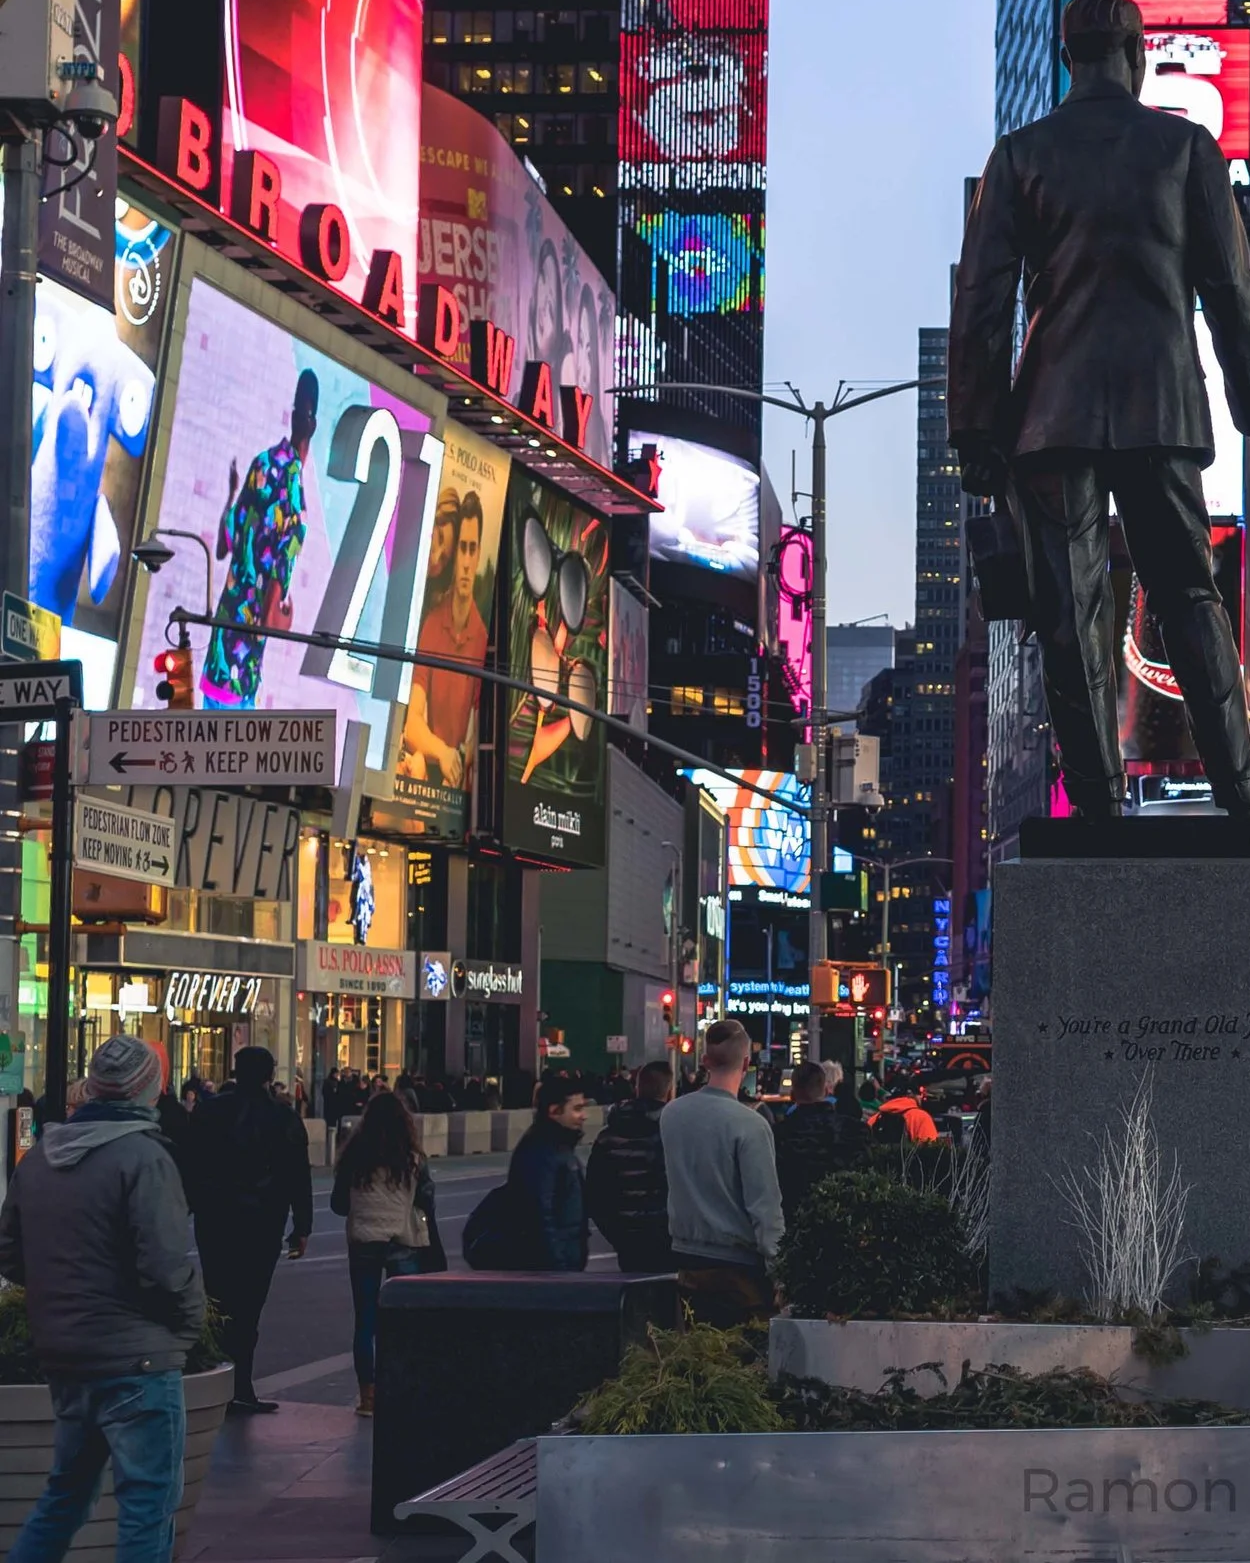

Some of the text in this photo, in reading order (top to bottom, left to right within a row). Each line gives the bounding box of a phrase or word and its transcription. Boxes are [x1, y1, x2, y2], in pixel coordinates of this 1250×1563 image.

[53, 229, 104, 273] THE BROADWAY
[62, 255, 91, 284] MUSICAL
[157, 97, 595, 450] BROADWAY
[326, 406, 446, 705] 21
[11, 614, 27, 643] ONE
[14, 679, 63, 704] WAY
[746, 657, 762, 729] 1500
[108, 720, 325, 743] PEDESTRIAN FLOW ZONE
[205, 751, 324, 773] KEEP MOVING
[408, 782, 464, 806] AUTHENTICALLY
[83, 806, 171, 848] PEDESTRIAN FLOW ZONE
[533, 802, 582, 836] alain mikli
[82, 837, 133, 869] KEEP MOVING
[318, 945, 406, 977] U.S. POLO ASSN.
[166, 971, 263, 1014] FOREVER 21
[339, 978, 364, 991] SINCE
[467, 965, 523, 998] sunglass hut
[730, 981, 770, 995] system
[1058, 1014, 1112, 1040] You're
[1118, 1020, 1131, 1035] a
[1134, 1015, 1198, 1039] Grand
[1205, 1015, 1239, 1035] Old
[1121, 1040, 1221, 1061] Over There
